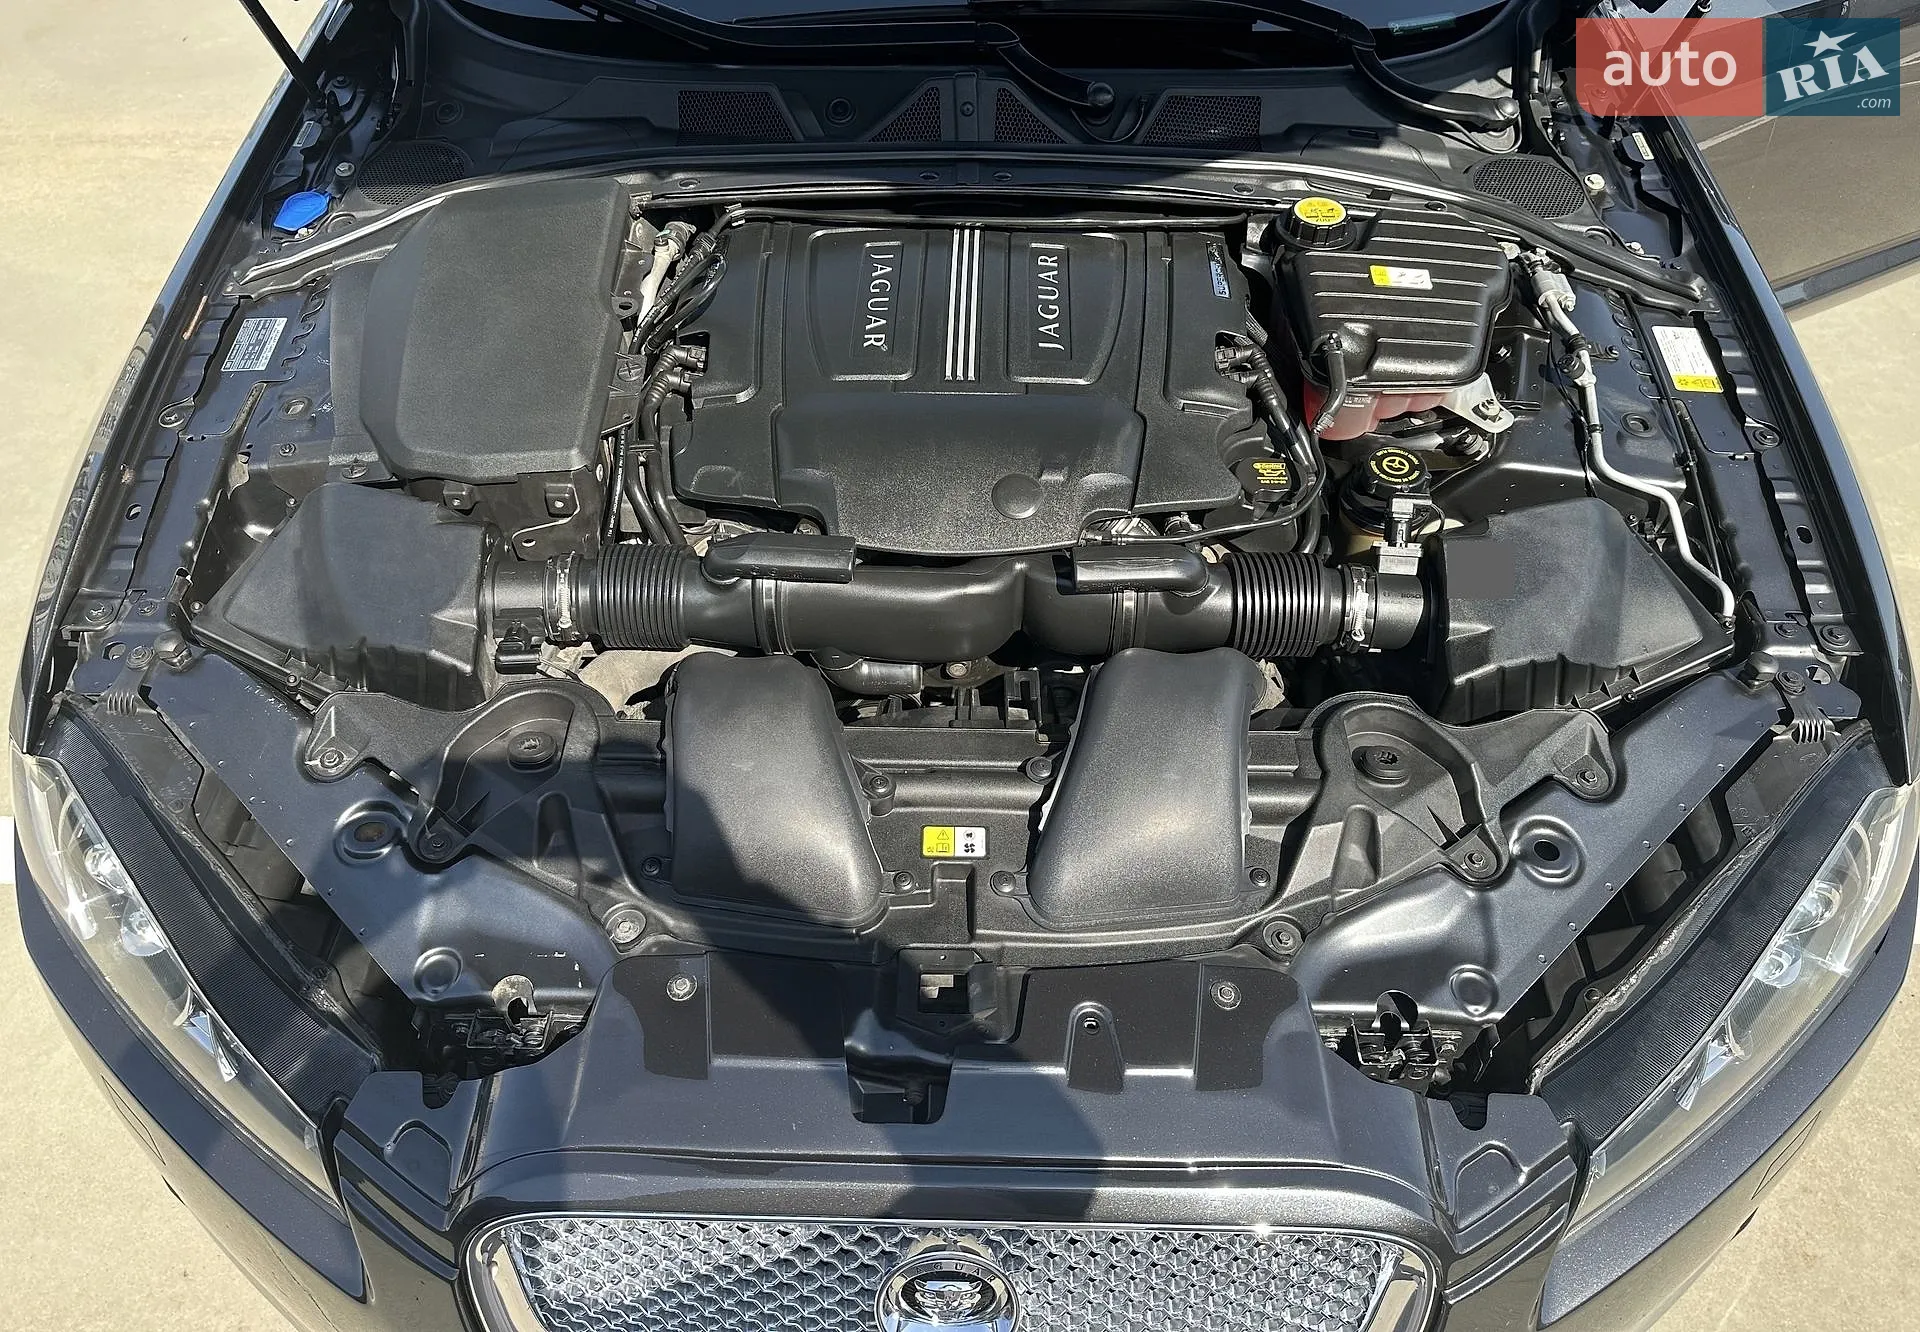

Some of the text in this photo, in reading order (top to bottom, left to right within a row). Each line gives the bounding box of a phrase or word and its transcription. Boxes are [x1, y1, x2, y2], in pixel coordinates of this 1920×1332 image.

[863, 253, 894, 349] JAGUAR
[1037, 254, 1065, 351] JAGUAR
[901, 1262, 997, 1283] JAGUAR
